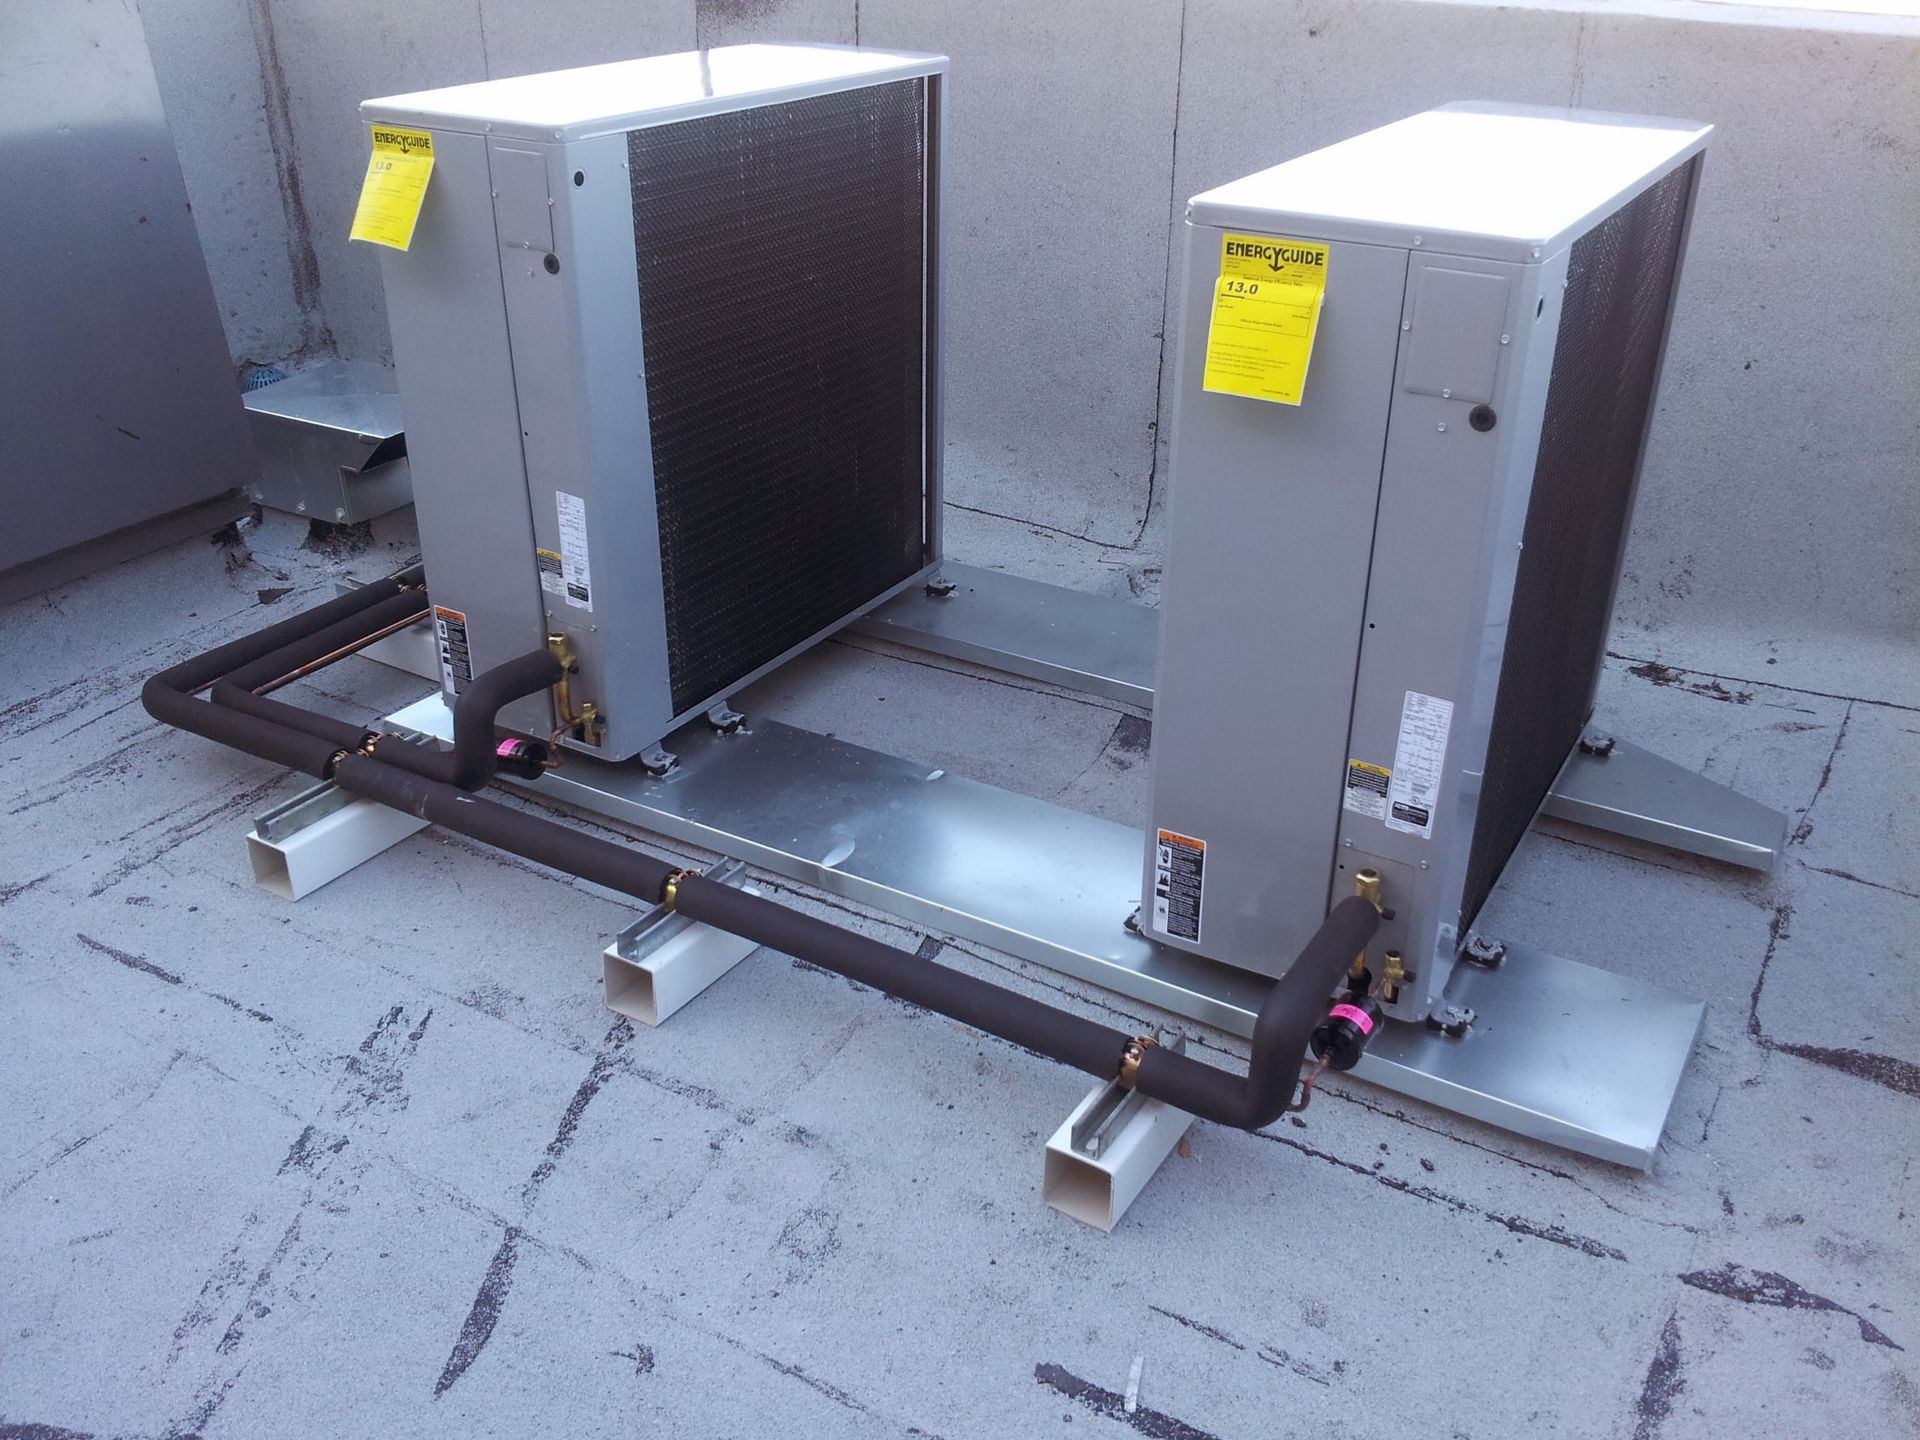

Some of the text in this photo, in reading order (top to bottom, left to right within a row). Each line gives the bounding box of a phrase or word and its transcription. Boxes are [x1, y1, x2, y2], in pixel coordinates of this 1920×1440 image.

[374, 132, 431, 150] ENERGYGUIDE
[1226, 241, 1325, 268] ENERGYGUIDE
[1226, 280, 1259, 295] 13.0
